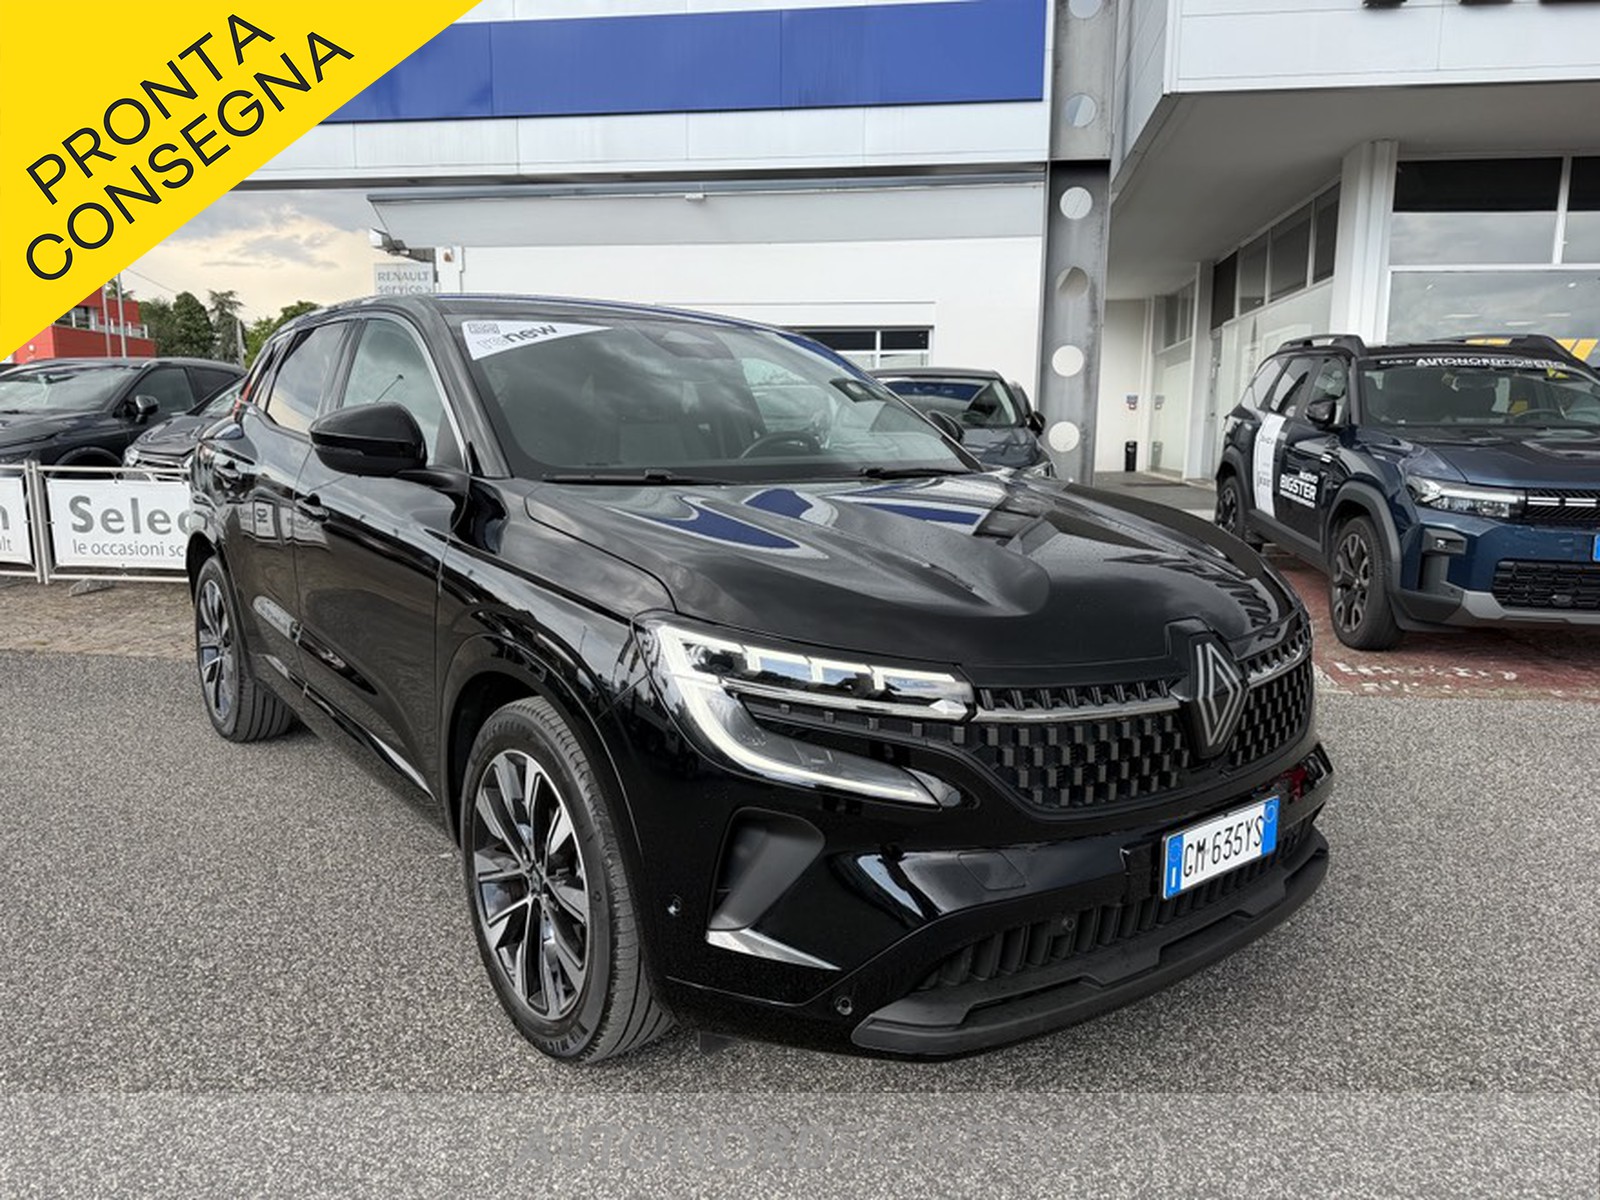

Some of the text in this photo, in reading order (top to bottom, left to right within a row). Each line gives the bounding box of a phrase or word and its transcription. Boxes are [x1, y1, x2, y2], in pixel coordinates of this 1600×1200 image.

[377, 271, 430, 282] RENAULT
[1279, 473, 1317, 501] BIGSTER
[72, 538, 87, 555] le
[90, 540, 165, 558] occasioni
[1183, 815, 1264, 878] GM 635YS
